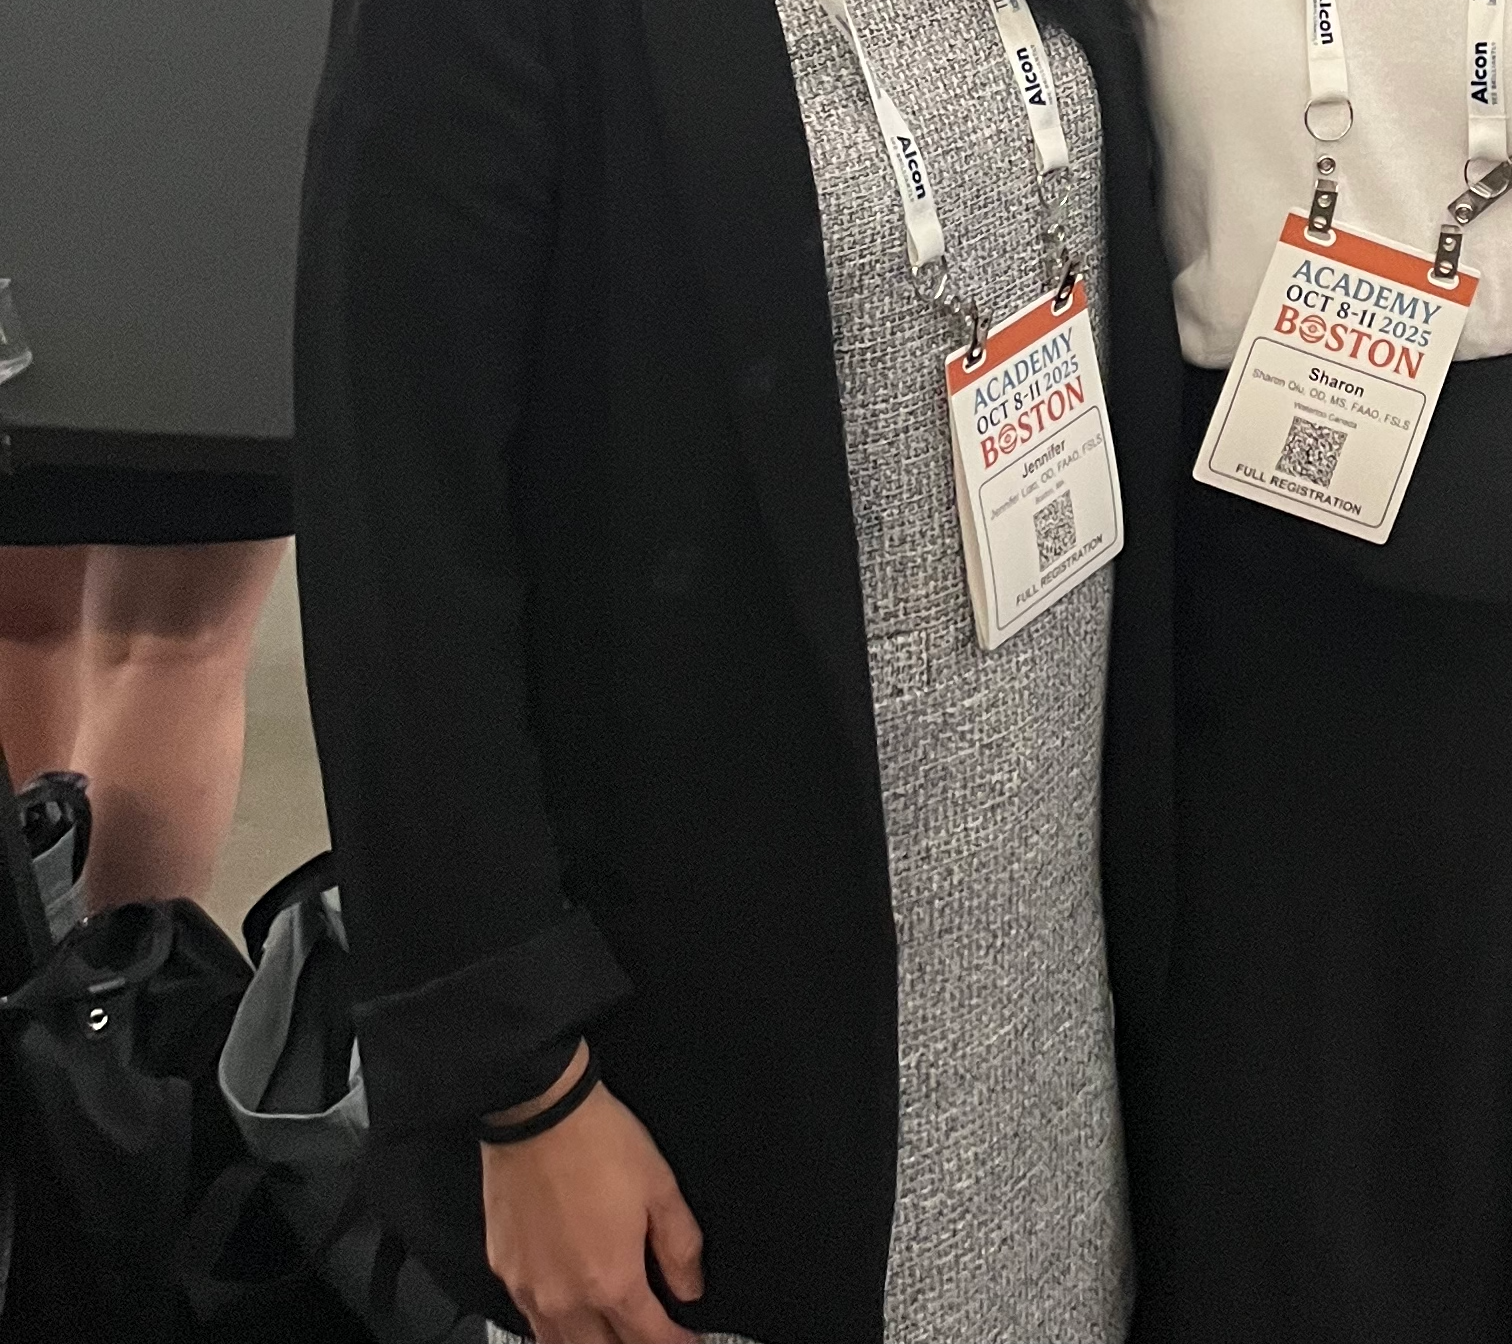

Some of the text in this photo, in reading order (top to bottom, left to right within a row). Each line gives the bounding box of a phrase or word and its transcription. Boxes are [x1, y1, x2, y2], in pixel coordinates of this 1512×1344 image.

[1016, 47, 1047, 106] Alcon
[1470, 41, 1489, 105] Alcon
[897, 135, 926, 200] Alcon
[1286, 284, 1431, 346] OCT 8-11 2025
[1292, 259, 1441, 324] ACADEMY
[974, 327, 1073, 415] ACADEMY
[1274, 304, 1425, 379] BOSTON
[977, 354, 1078, 434] OCT 8-11 2025
[1308, 367, 1364, 397] Sharon
[980, 375, 1084, 470] BOSTON
[1022, 440, 1065, 478] Jennifer
[1235, 463, 1362, 515] FULL REGISTRATION
[1016, 534, 1103, 606] FULL REGISTRATION
